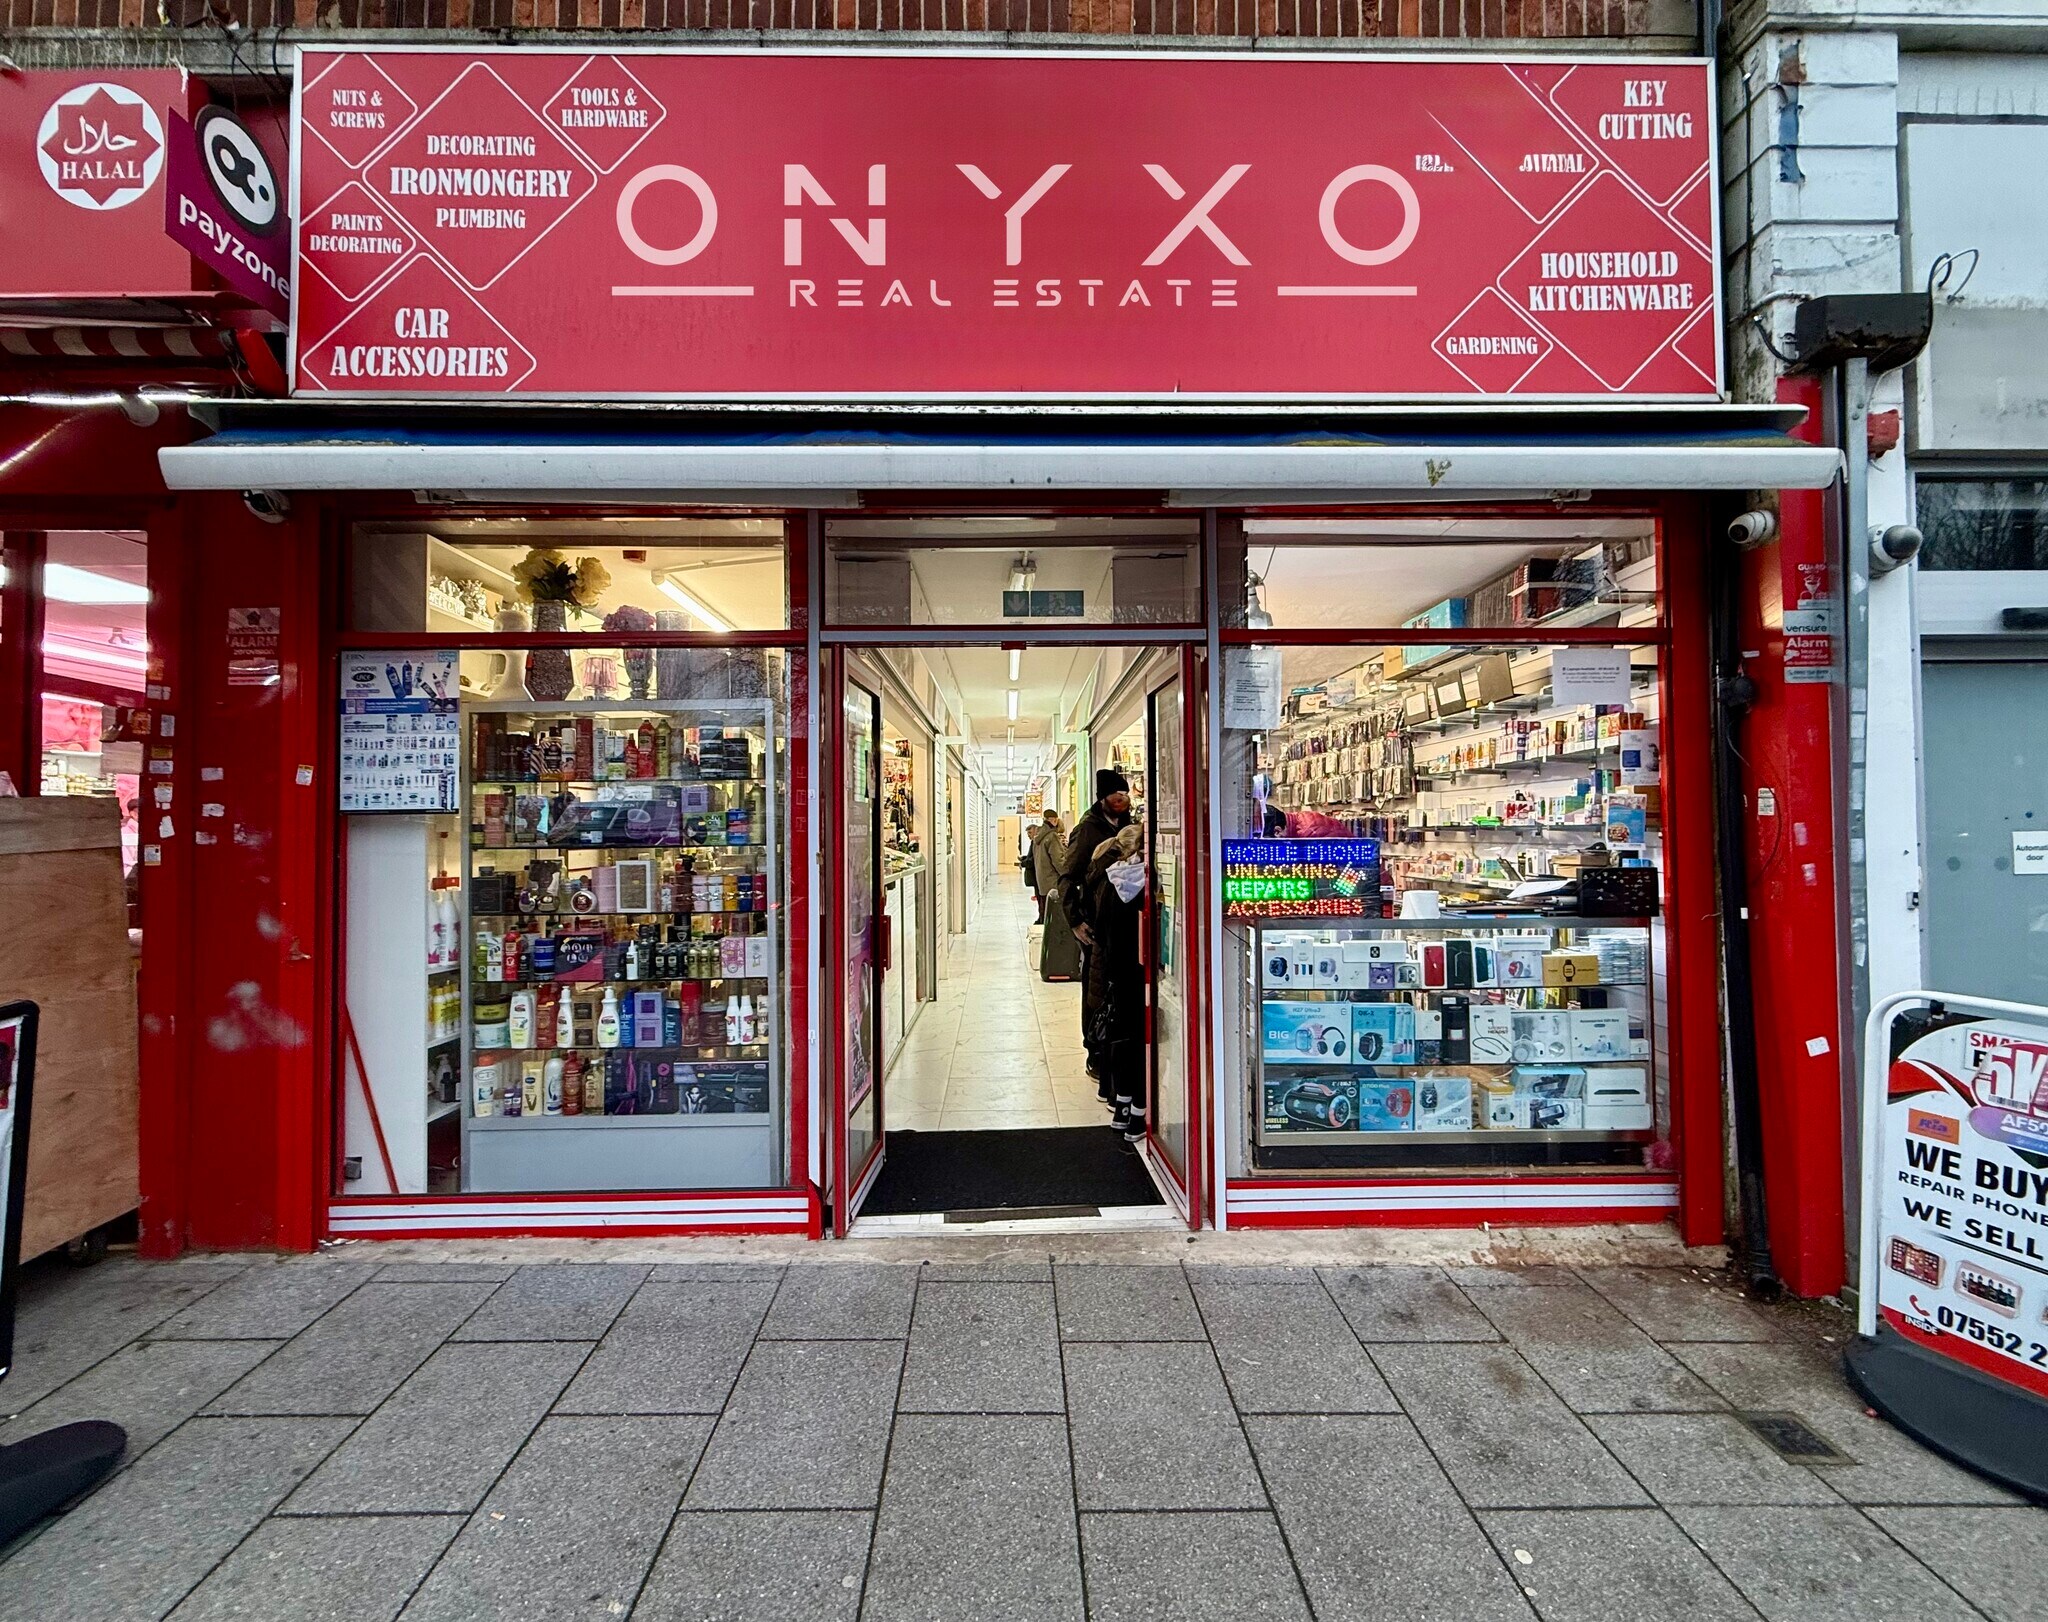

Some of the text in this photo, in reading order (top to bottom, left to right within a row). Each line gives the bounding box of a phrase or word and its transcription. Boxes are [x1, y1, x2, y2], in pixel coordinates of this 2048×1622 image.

[332, 89, 383, 107] NUTS &
[570, 87, 637, 107] TOOLS &
[1623, 80, 1668, 107] KEY
[330, 111, 385, 129] SCREWS
[561, 108, 649, 129] HARDWARE
[1598, 112, 1693, 140] CUTTING
[64, 115, 138, 154] حلال
[427, 135, 536, 157] DECORATING
[61, 160, 141, 180] HALAL
[389, 167, 572, 198] IRONMONGERY
[331, 213, 384, 232] PAINTS
[436, 207, 526, 229] PLUMBING
[616, 164, 1420, 266] ONYXO
[179, 193, 291, 300] payzone
[309, 234, 403, 255] DECORATING
[1540, 251, 1679, 279] HOUSEHOLD
[789, 279, 1238, 307] REAL ESTATE
[1528, 283, 1694, 312] KITCHENWARE
[394, 307, 450, 339] CAR
[1445, 336, 1539, 355] GARDENING
[329, 345, 509, 377] ACCESSORIES
[1785, 625, 1828, 633] verisure
[1786, 637, 1829, 648] Alarm
[1226, 845, 1373, 862] MOBILE PHONE
[1226, 863, 1338, 879] UNLOCKING
[1227, 898, 1364, 917] ACCESSORIES
[1268, 1030, 1289, 1039] BIG
[1905, 1138, 2048, 1207] WE BUY
[1898, 1170, 1966, 1202] REPAIR
[1903, 1197, 2044, 1261] WE SELL
[1904, 1315, 1939, 1336] INSIDE
[1937, 1305, 2022, 1357] 07552
